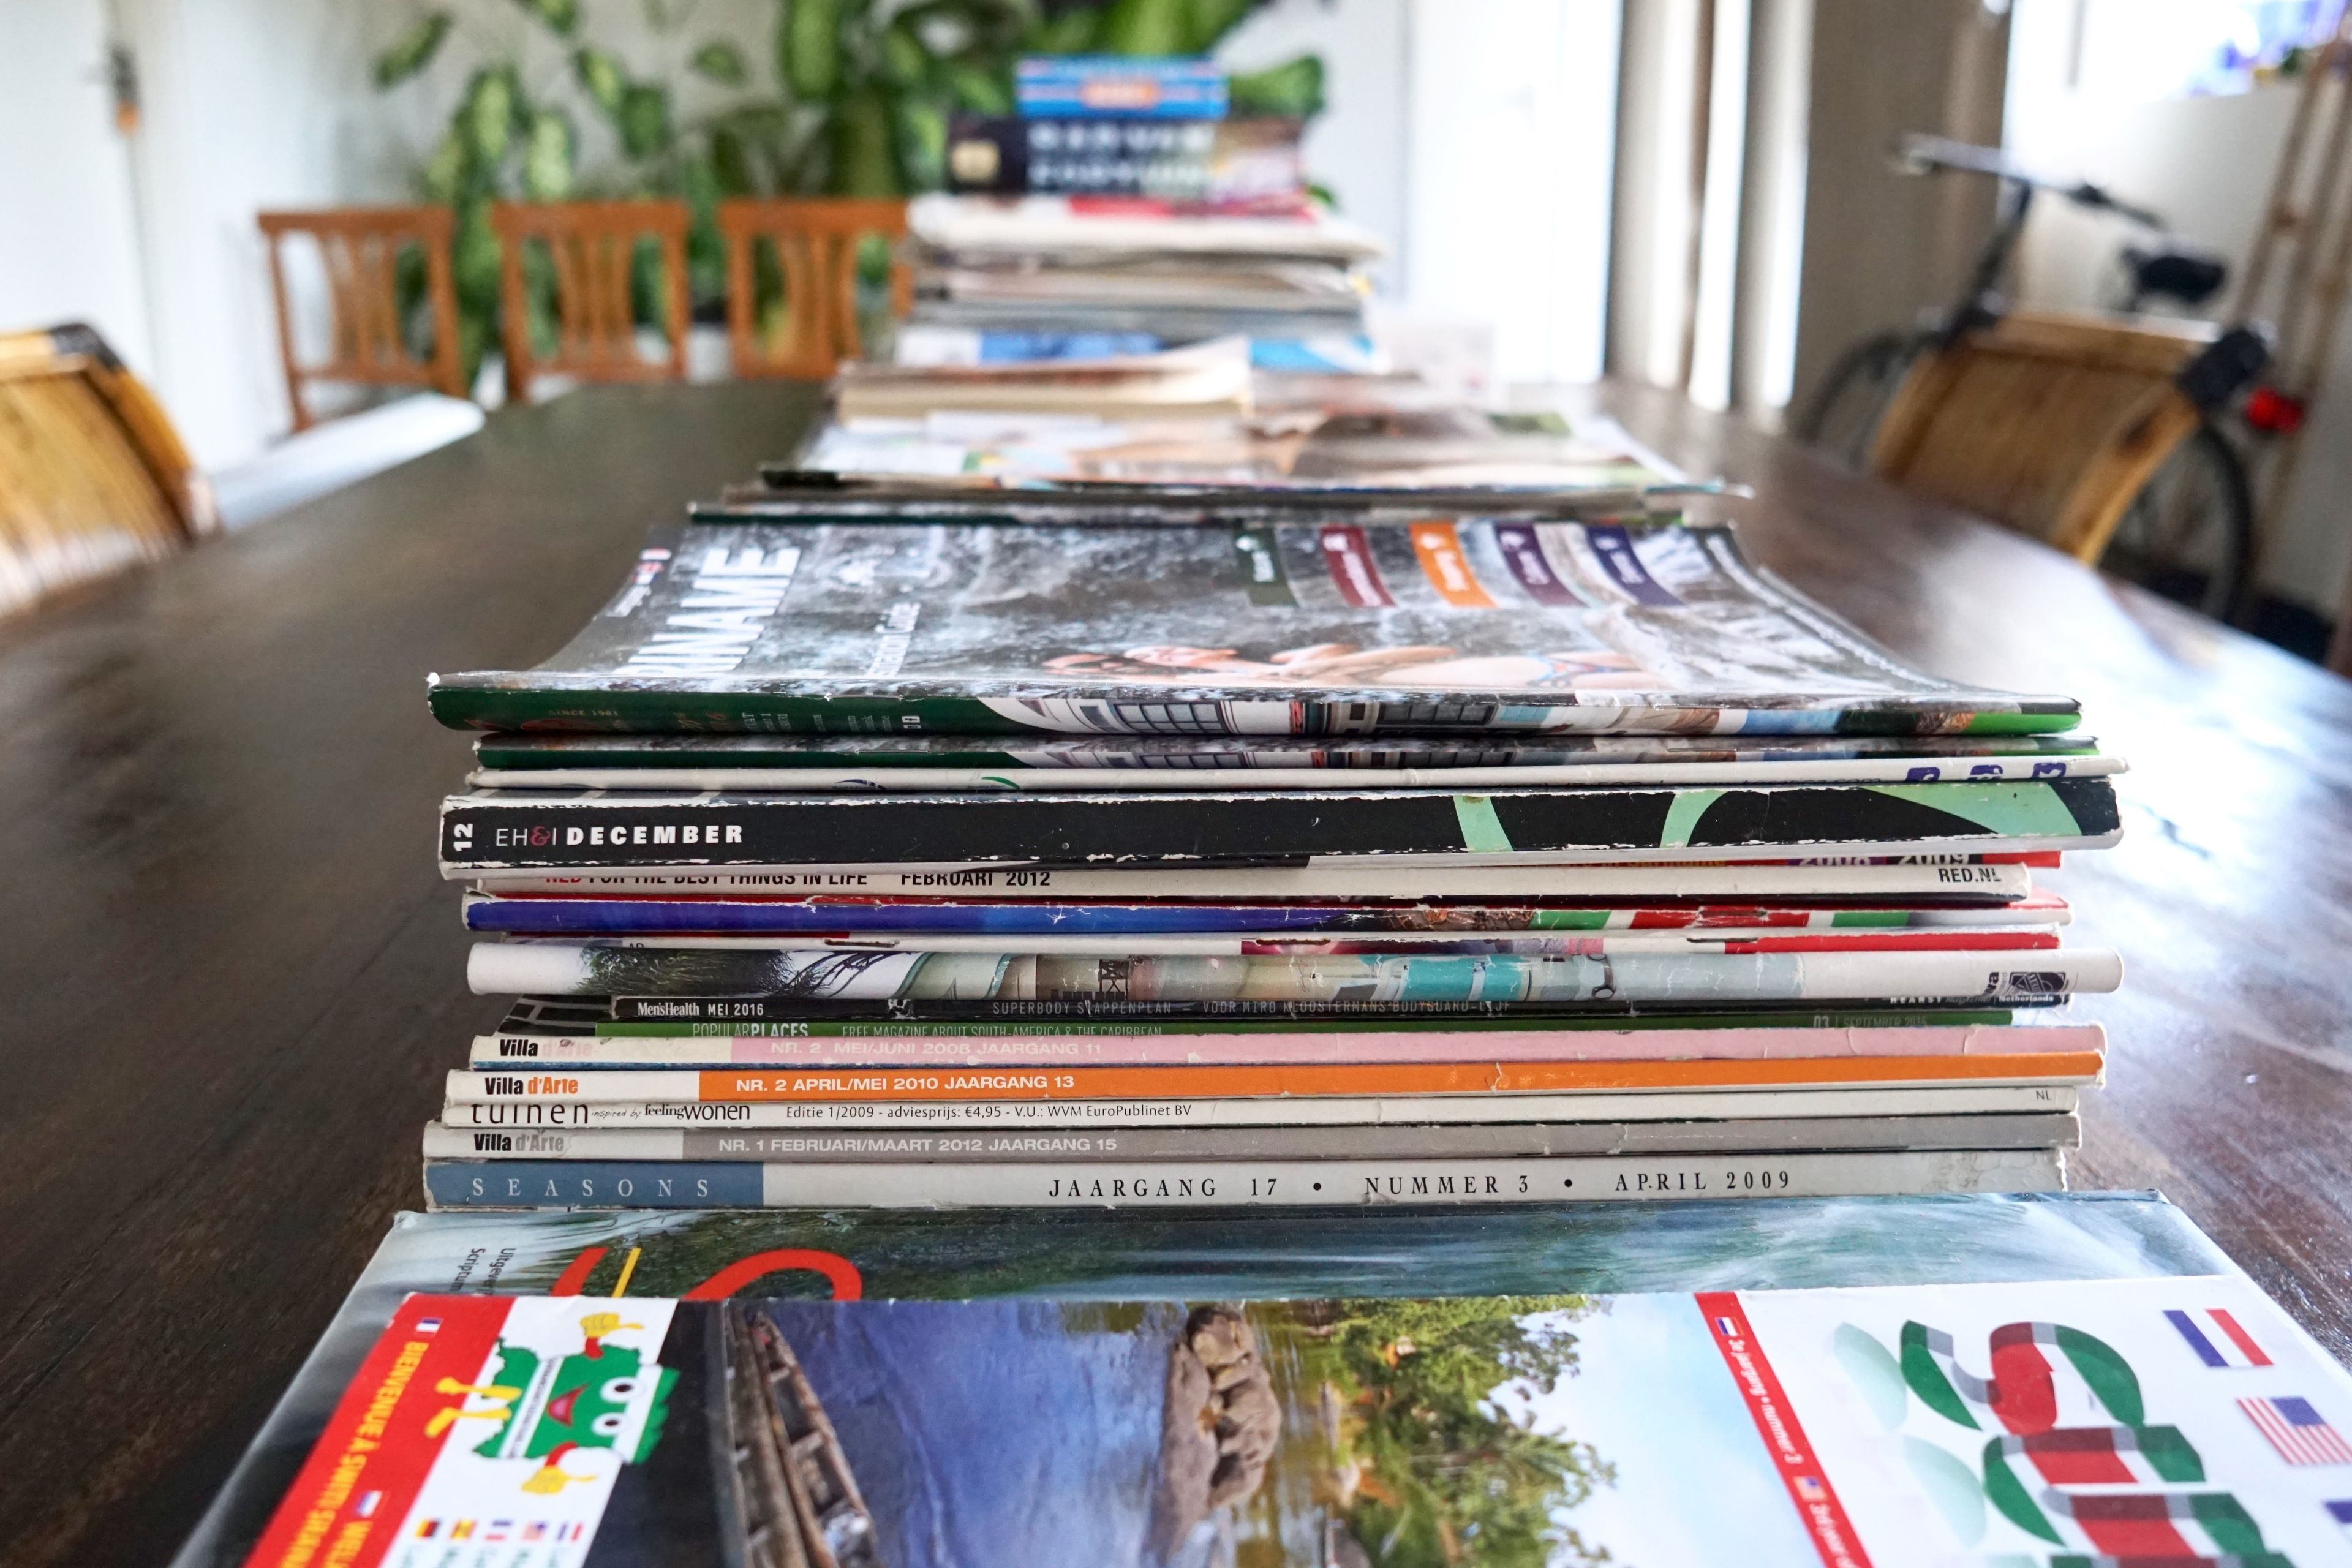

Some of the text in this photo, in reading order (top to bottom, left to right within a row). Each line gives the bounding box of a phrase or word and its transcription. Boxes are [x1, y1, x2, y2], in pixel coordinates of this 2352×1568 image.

[453, 823, 473, 851] 12
[566, 825, 742, 846] DECEMBER
[901, 872, 993, 886] FEBRUARI
[1006, 872, 1050, 886] 2012
[1938, 867, 2002, 883] RED.NL
[1998, 994, 2054, 1003] Netherlands
[707, 1004, 729, 1016] MEI
[734, 1003, 764, 1016] 2016
[992, 1002, 1070, 1014] SUPERBODY
[1203, 1001, 1236, 1013] VOOR
[1242, 1001, 1276, 1013] MIRO
[873, 1026, 928, 1036] MAGAZINE
[499, 1039, 538, 1057] Villa
[809, 1043, 821, 1054] 2
[834, 1042, 916, 1054] MEI/JUNI
[922, 1042, 970, 1054] 2008
[977, 1043, 1079, 1054] JAARGANG
[1085, 1042, 1101, 1054] 11
[484, 1076, 1075, 1095] Villa d'Arte NR. 2 APRIL/MEI 2010 JAARGANG 13
[2036, 1090, 2051, 1101] NL
[470, 1104, 589, 1124] tuinen
[591, 1107, 627, 1117] inspired
[630, 1107, 641, 1119] by
[786, 1106, 823, 1118] Editie
[829, 1106, 874, 1119] 1/2009
[887, 1106, 960, 1121] adviesprijs:
[965, 1106, 1002, 1119] €4,95
[1014, 1106, 1043, 1118] V.U.:
[1047, 1105, 1082, 1117] WVM
[1087, 1104, 1171, 1117] EuroPublinet
[1175, 1104, 1192, 1116] BV
[474, 1133, 1117, 1152] Villa d'Arte NR. 1 FEBRUARI/MAART 2012 JAARGANG 15
[472, 1170, 1790, 1197] SEASONS JAARGANG 17 NUMMER 3 APRIL 2009
[449, 1248, 486, 1292] Scriptum
[356, 1341, 429, 1438] BIENVENUE
[1730, 1351, 1769, 1396] jaargang
[1760, 1403, 1797, 1454] nummer
